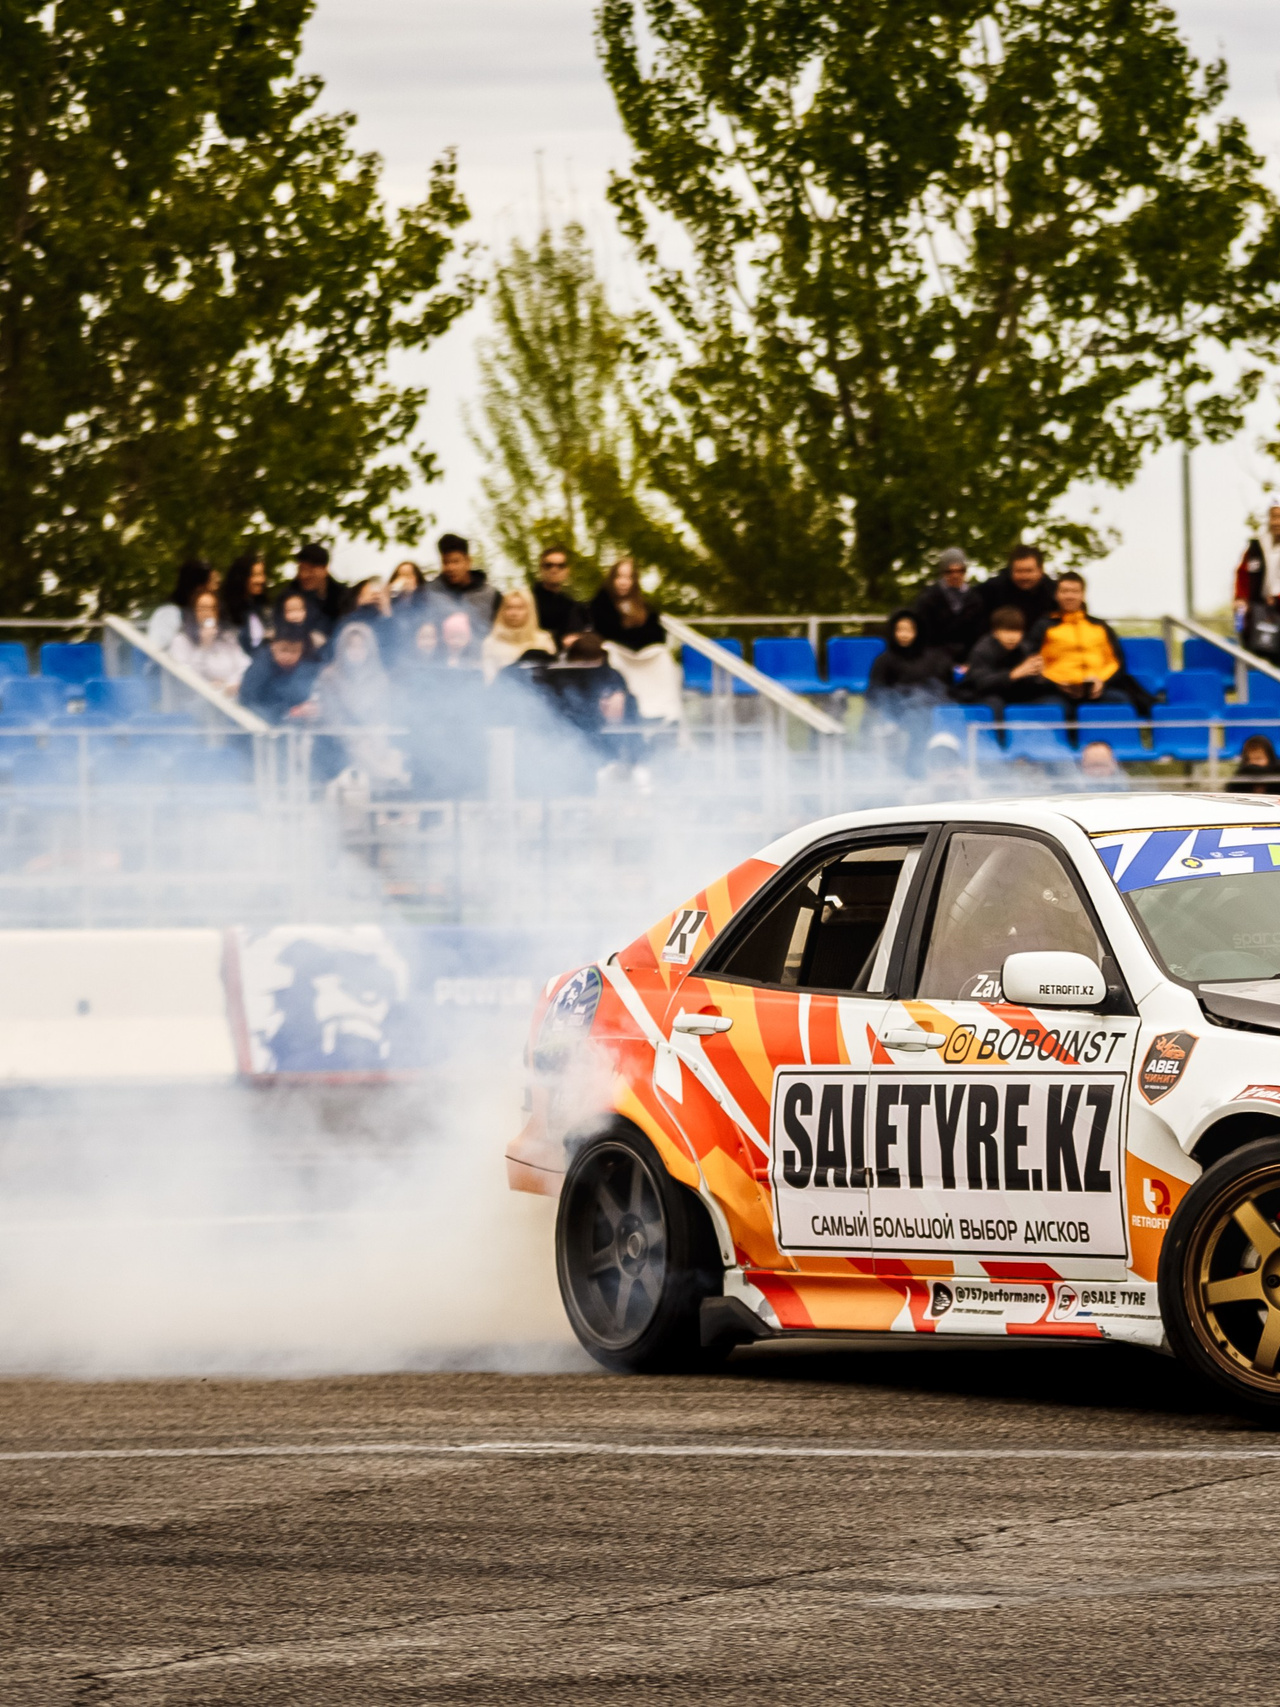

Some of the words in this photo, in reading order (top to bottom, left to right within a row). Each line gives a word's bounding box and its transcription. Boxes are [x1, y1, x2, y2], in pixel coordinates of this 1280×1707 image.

[1039, 985, 1094, 995] RETROFIT.KZ
[977, 1028, 1127, 1064] BOBOINST
[1146, 1060, 1180, 1074] ABEL
[783, 1082, 1115, 1193] SALETYRE.KZ
[811, 1210, 869, 1237] САМЫЙ
[873, 1213, 955, 1240] БОЛЬШОЙ
[959, 1218, 1018, 1242] ВЫБОР
[1024, 1220, 1091, 1244] ДИСКОВ
[955, 1286, 1047, 1304] @757performance
